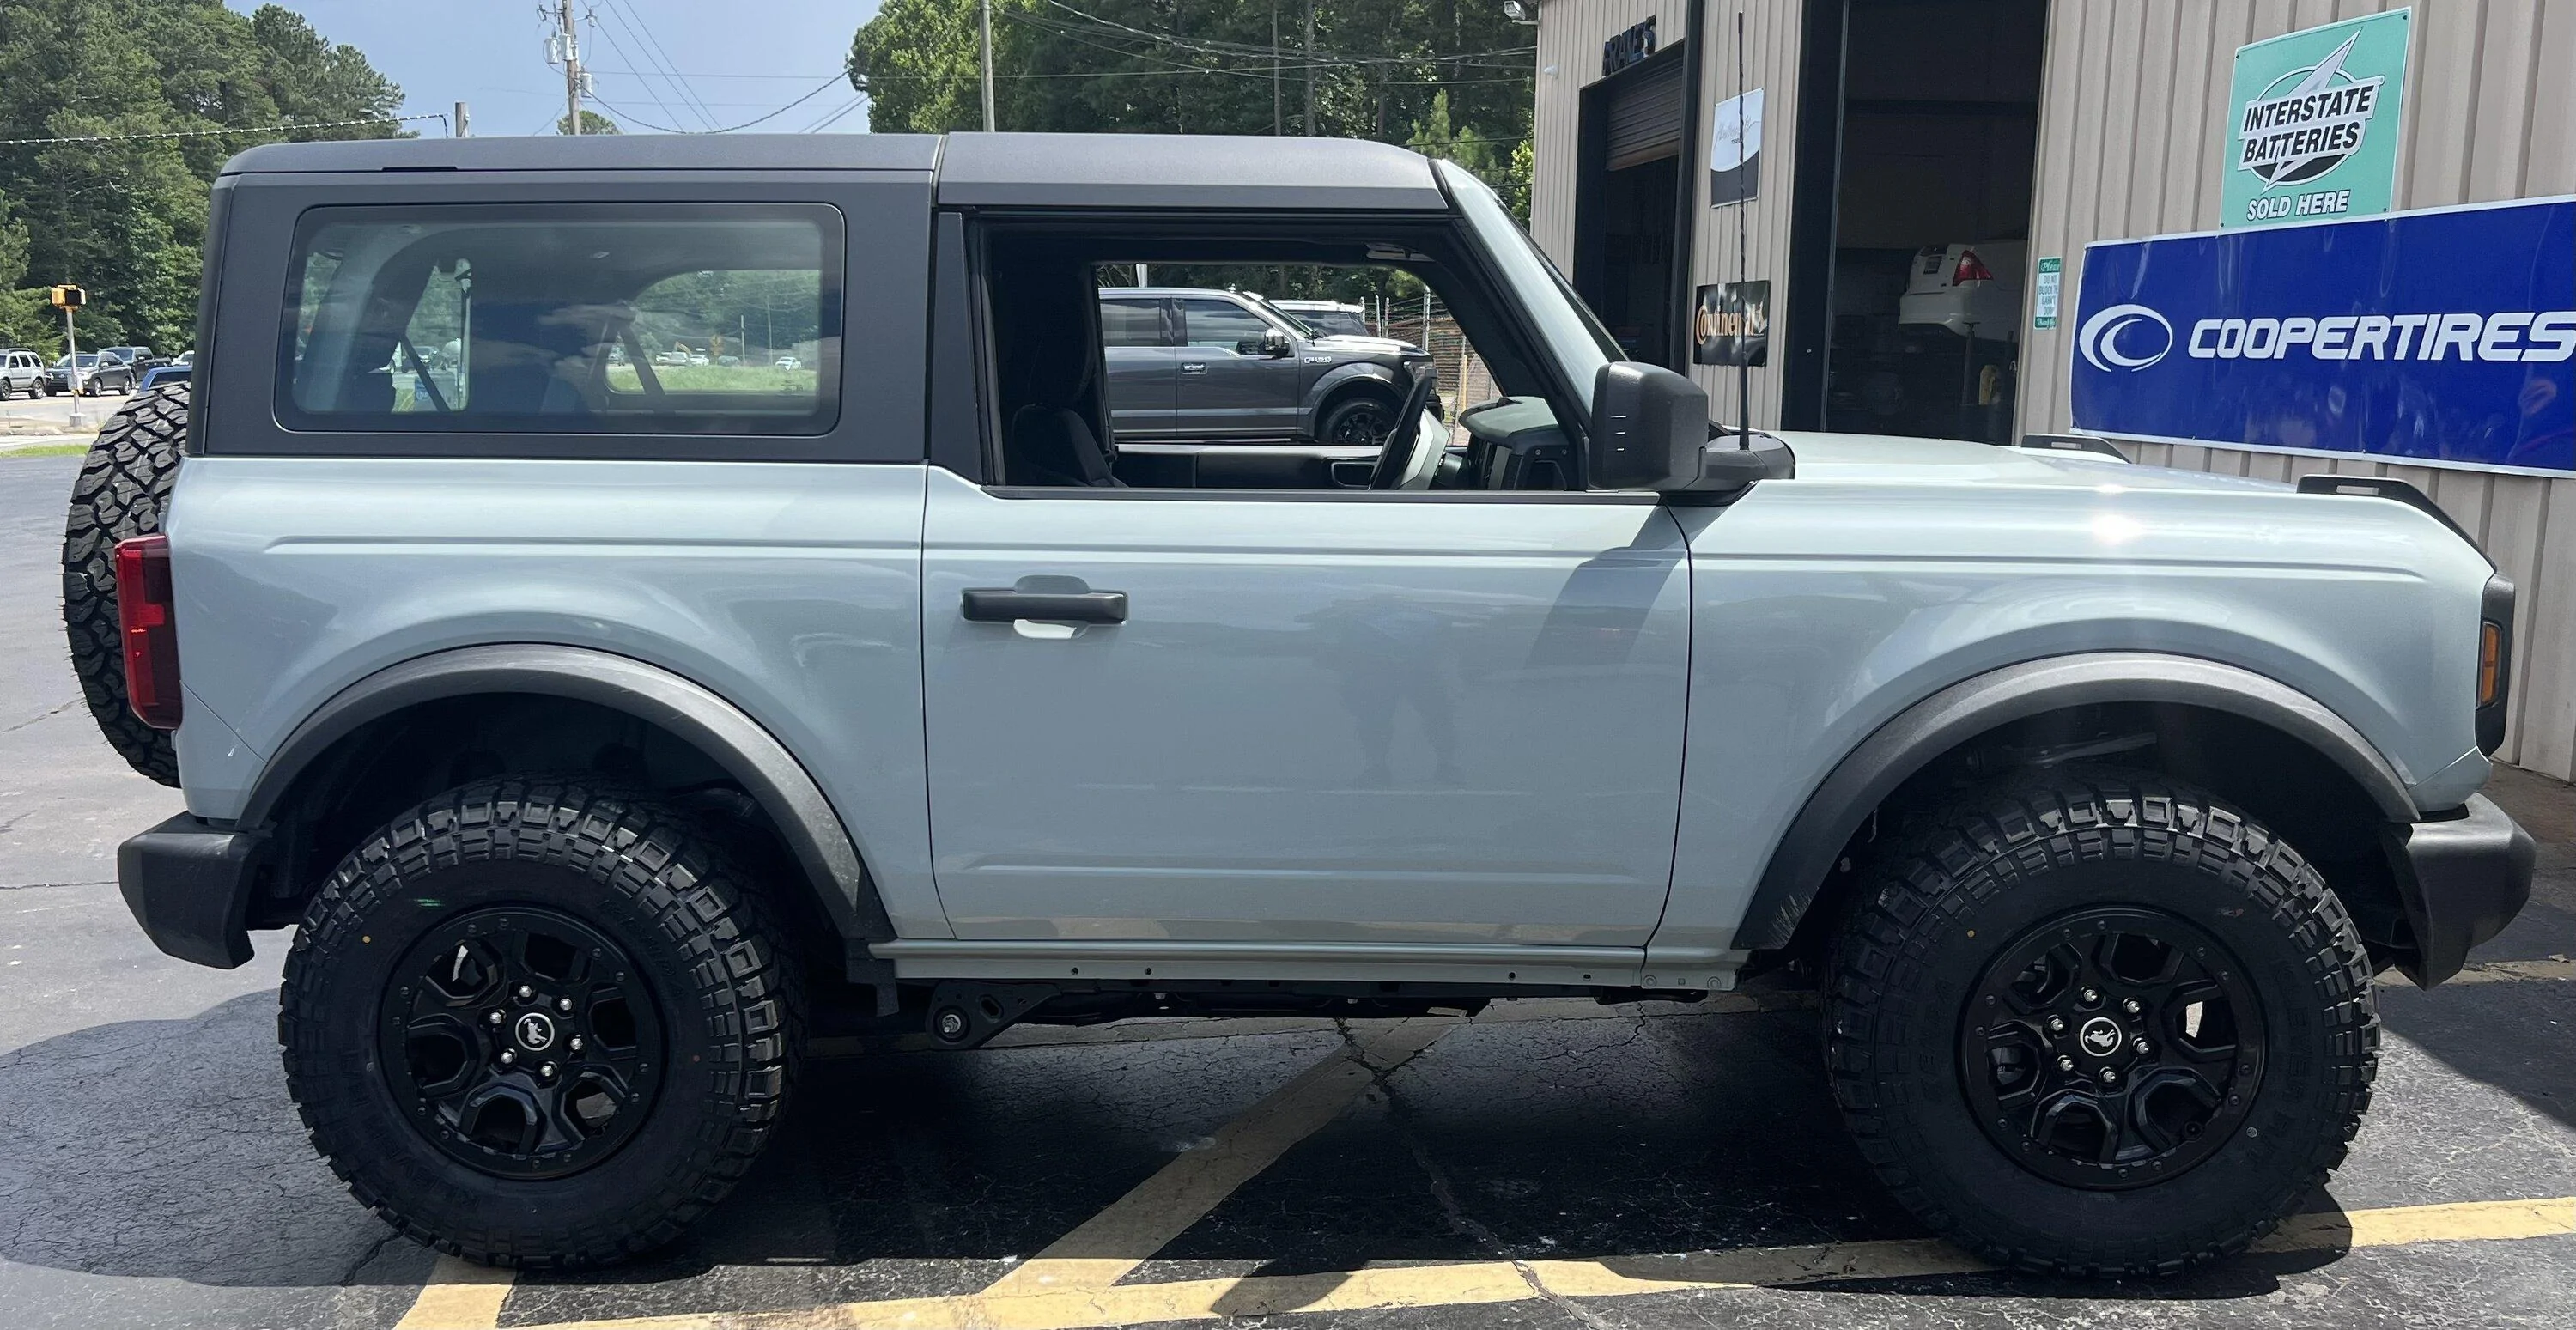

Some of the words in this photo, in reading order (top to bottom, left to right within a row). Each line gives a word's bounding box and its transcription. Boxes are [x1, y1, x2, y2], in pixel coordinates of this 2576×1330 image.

[2243, 84, 2374, 132] INTERSTATE
[2243, 121, 2360, 163] BATTERIES
[2246, 195, 2292, 222] SOLD
[2295, 189, 2351, 217] HERE
